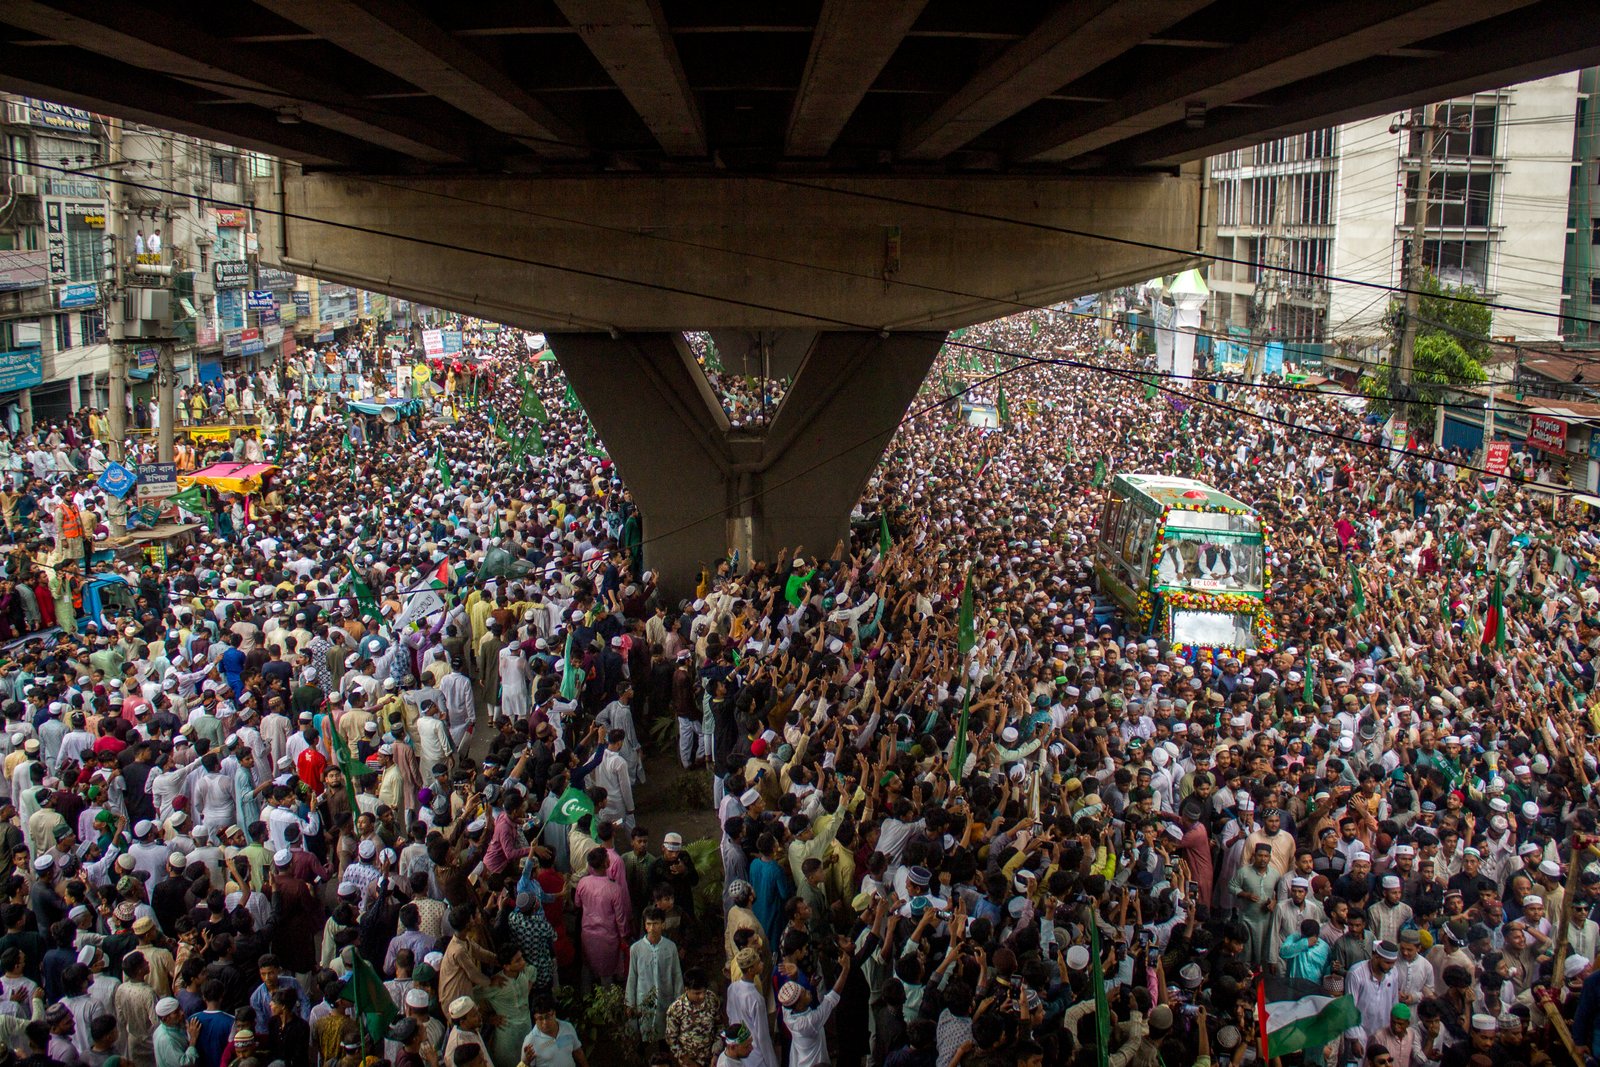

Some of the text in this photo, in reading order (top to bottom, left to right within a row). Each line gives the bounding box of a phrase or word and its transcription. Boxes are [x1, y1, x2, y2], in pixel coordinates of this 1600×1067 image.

[1536, 417, 1560, 433] Surprise
[1532, 429, 1563, 449] Chittagong
[138, 465, 174, 474] সিটি বাস
